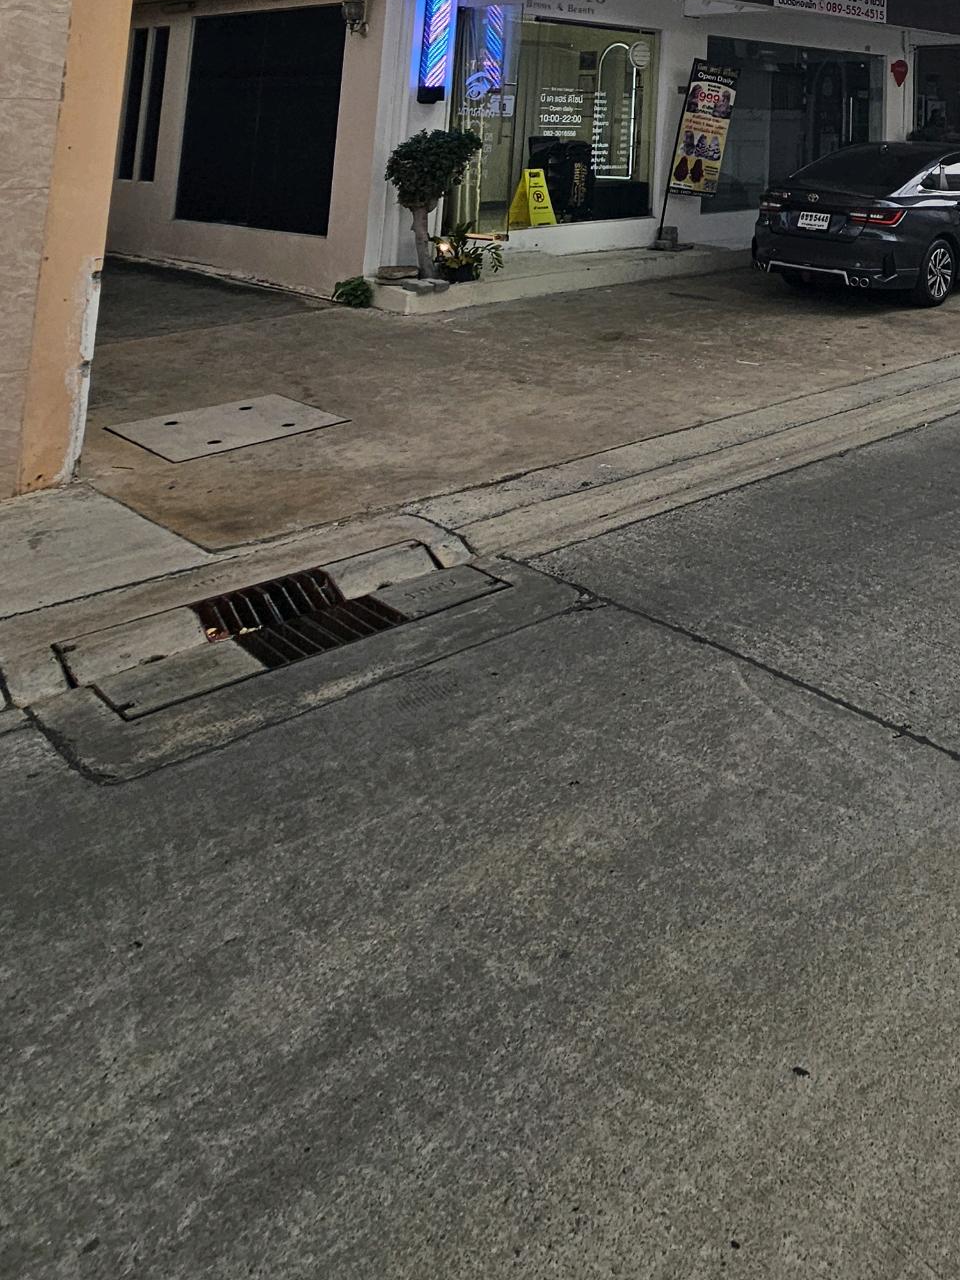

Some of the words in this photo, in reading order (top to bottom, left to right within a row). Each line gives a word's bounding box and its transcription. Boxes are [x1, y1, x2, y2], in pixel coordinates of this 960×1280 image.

[826, 2, 885, 20] 089-552-4515
[697, 71, 716, 81] Open
[717, 76, 734, 86] Daily
[699, 91, 720, 104] 999
